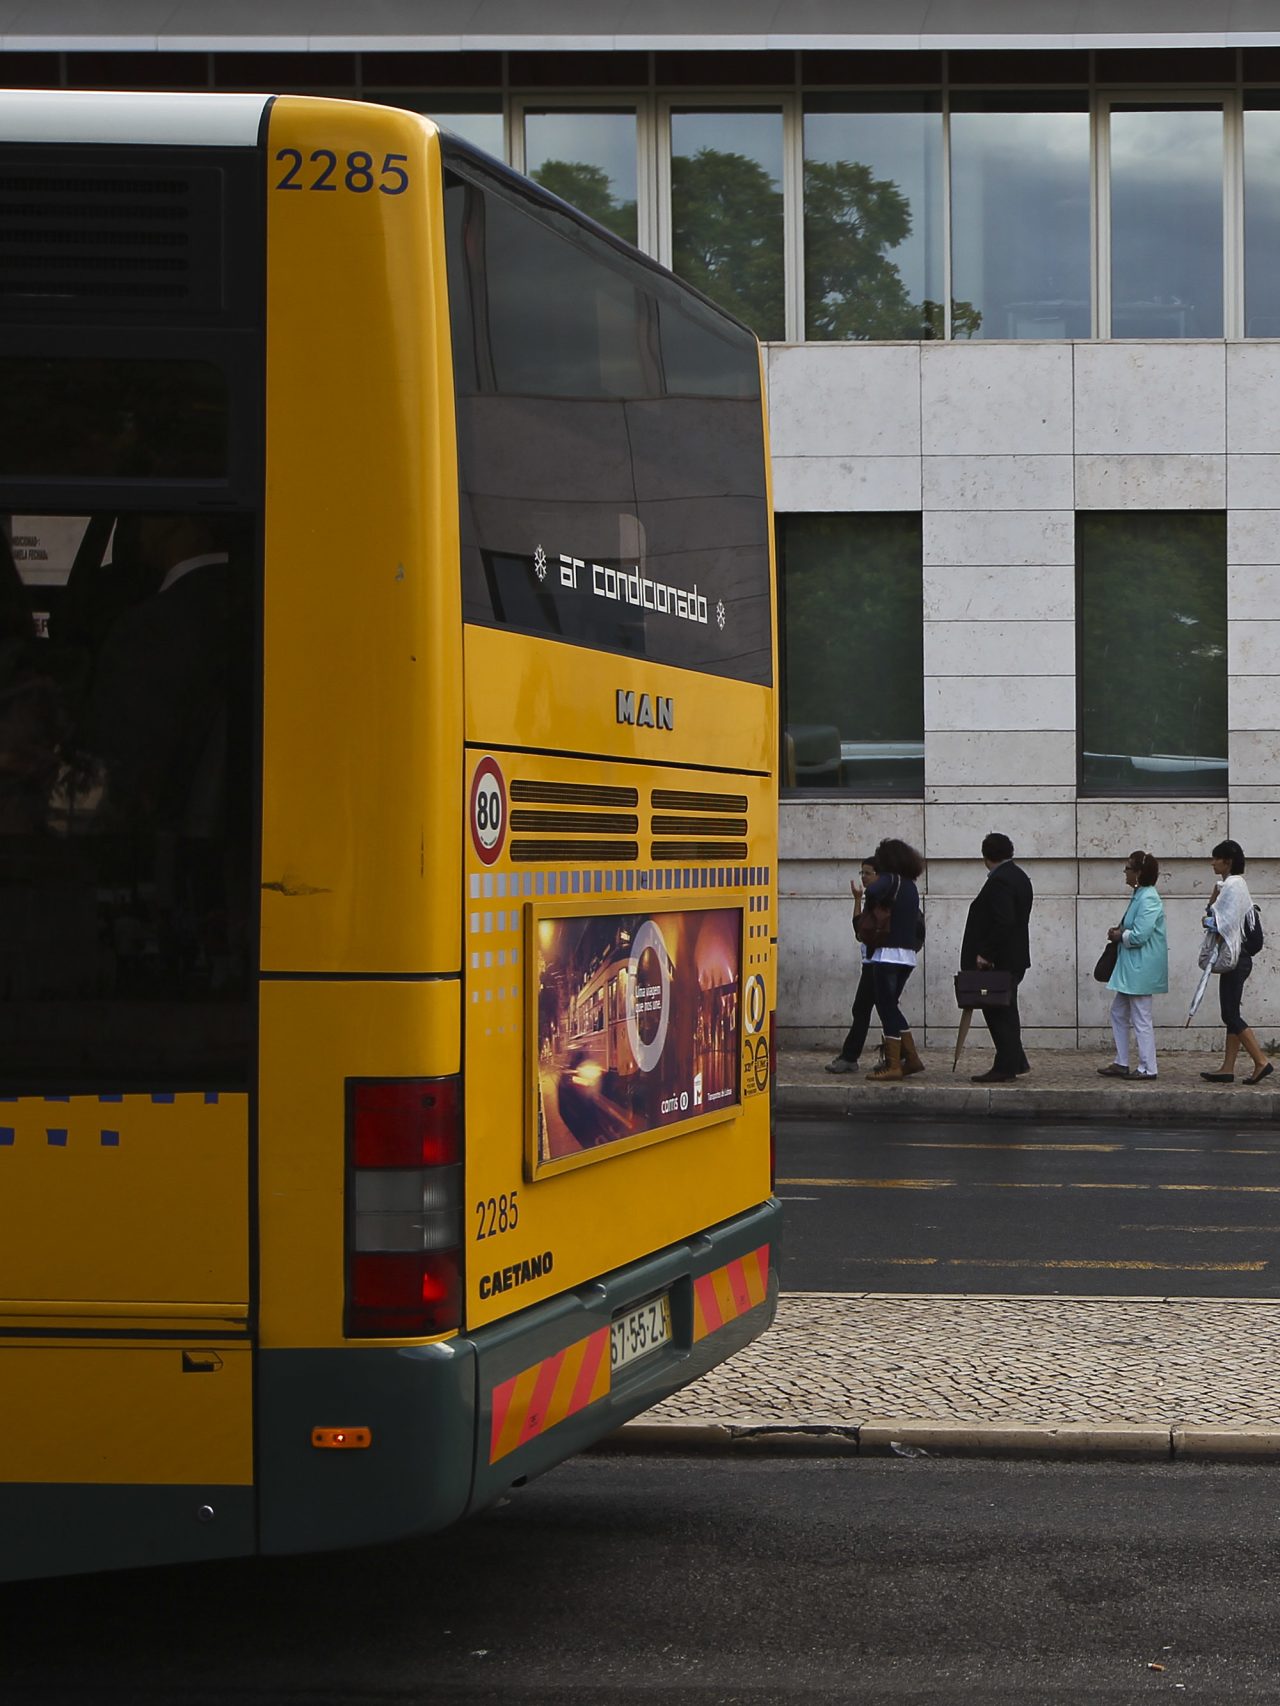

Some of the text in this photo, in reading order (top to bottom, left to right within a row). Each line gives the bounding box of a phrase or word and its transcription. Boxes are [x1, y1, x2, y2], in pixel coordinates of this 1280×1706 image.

[275, 148, 409, 195] 2285
[559, 554, 708, 625] ar condicionado
[616, 688, 673, 731] MAN
[477, 791, 500, 831] 80
[476, 1191, 518, 1241] 2285
[479, 1251, 554, 1300] CAETANO
